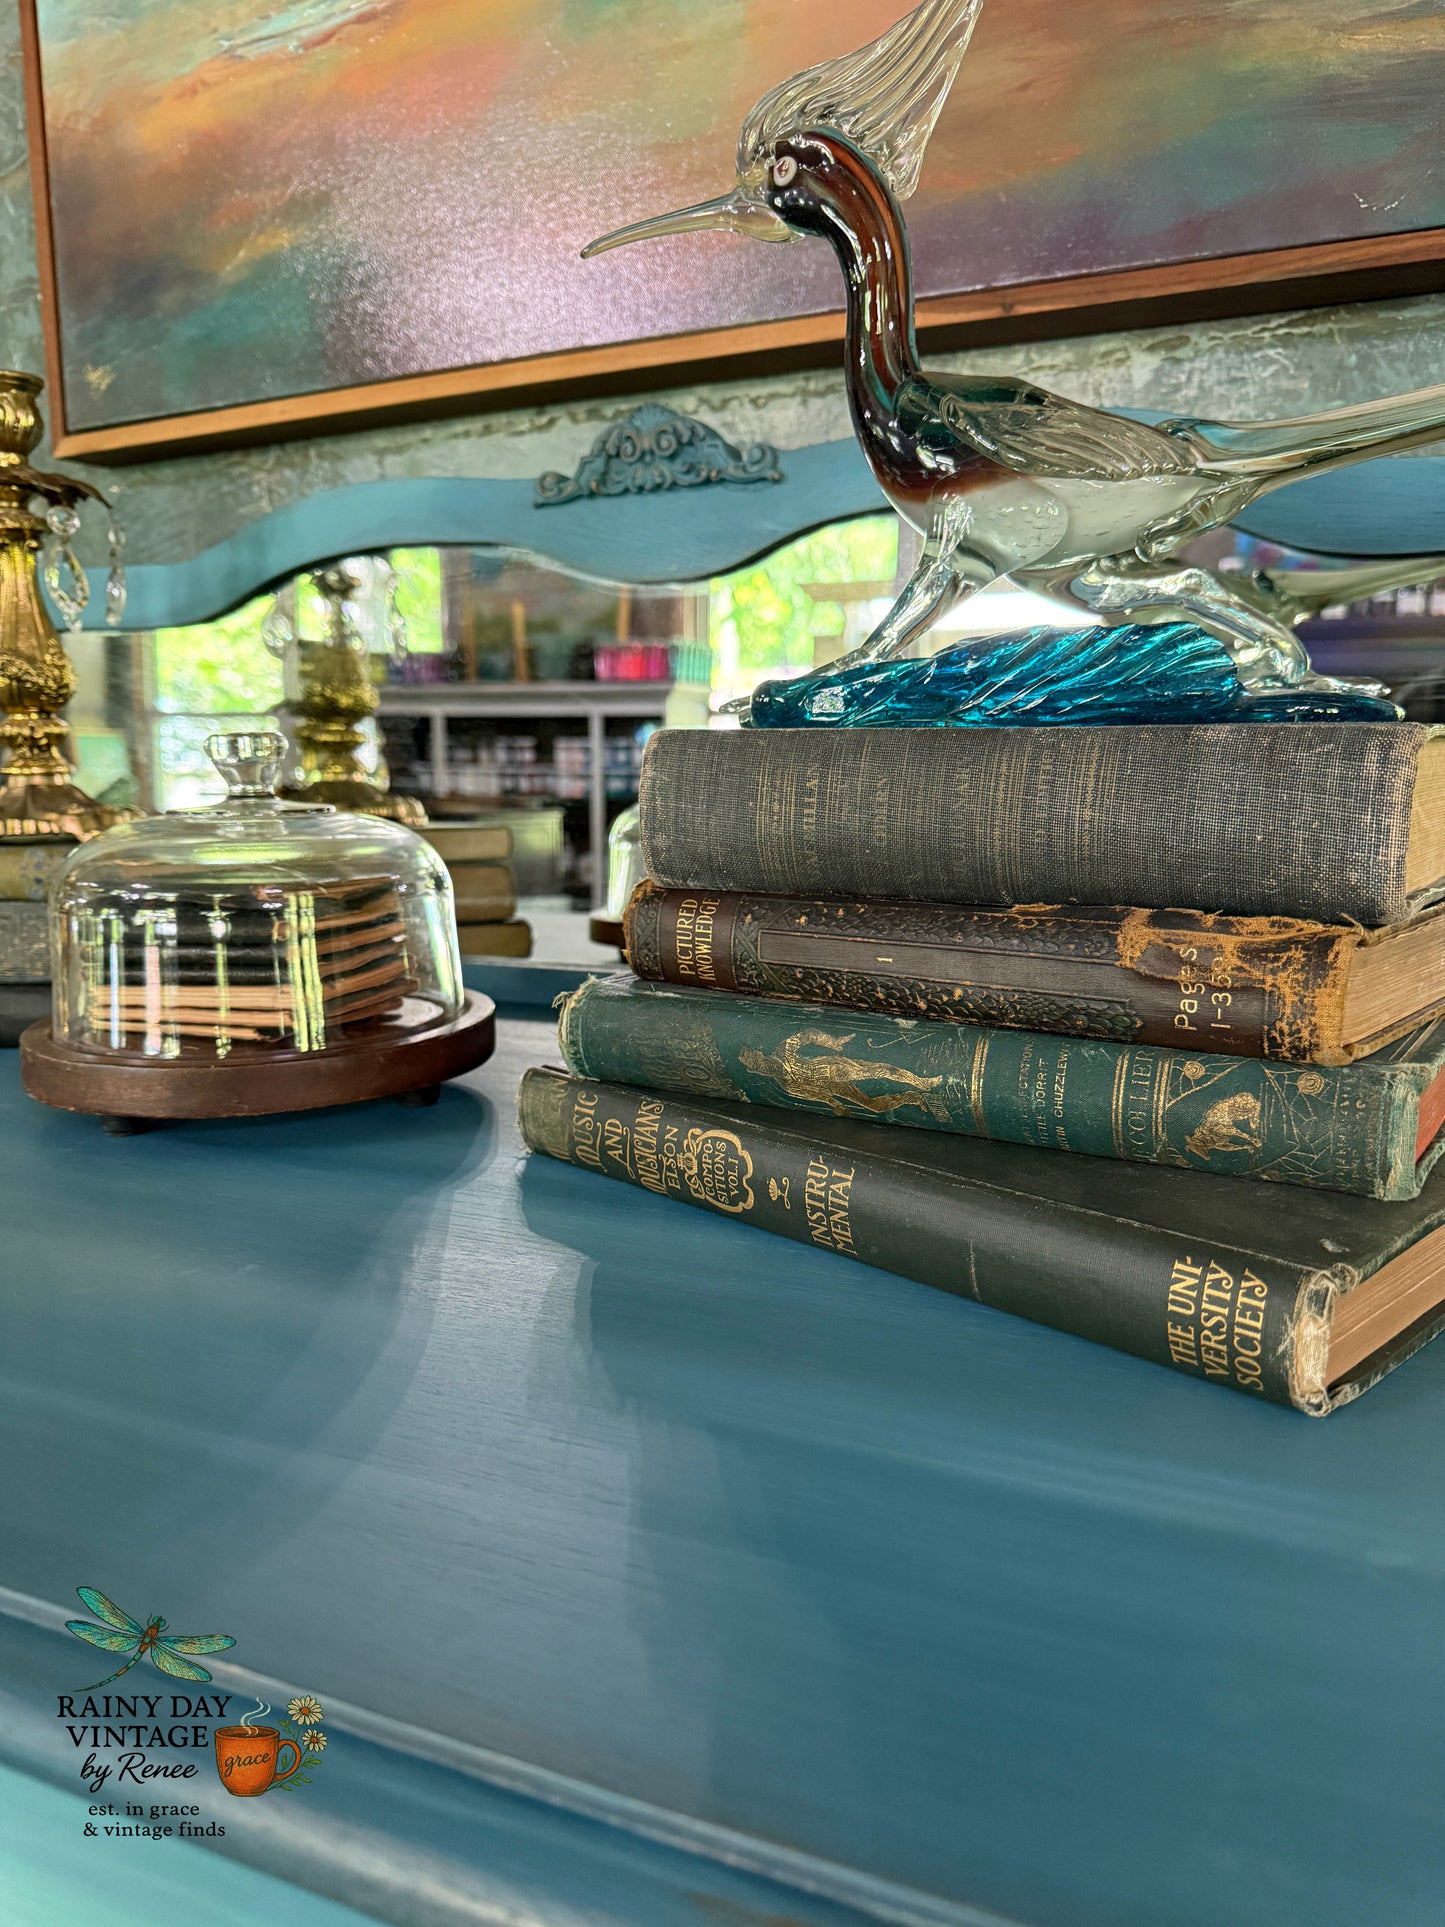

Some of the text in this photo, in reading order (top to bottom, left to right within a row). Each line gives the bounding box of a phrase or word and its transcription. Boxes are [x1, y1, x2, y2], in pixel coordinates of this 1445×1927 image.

[676, 899, 698, 976] PICTURED
[695, 897, 720, 981] KNOWLEDGE
[1174, 947, 1205, 1031] Pages
[1035, 1058, 1049, 1107] DORRIT
[573, 1091, 606, 1172] MUSIC
[605, 1119, 633, 1174] AND
[634, 1100, 671, 1197] MUSICIANS
[664, 1125, 681, 1190] ELSON
[702, 1139, 716, 1196] COMPO-
[714, 1141, 730, 1204] SITIONS
[805, 1155, 834, 1247] INSTRU-
[828, 1167, 857, 1256] MENTAL
[1167, 1255, 1203, 1366] THE UNI-
[1200, 1259, 1234, 1376] VERSITY
[1233, 1267, 1268, 1392] SOCIETY
